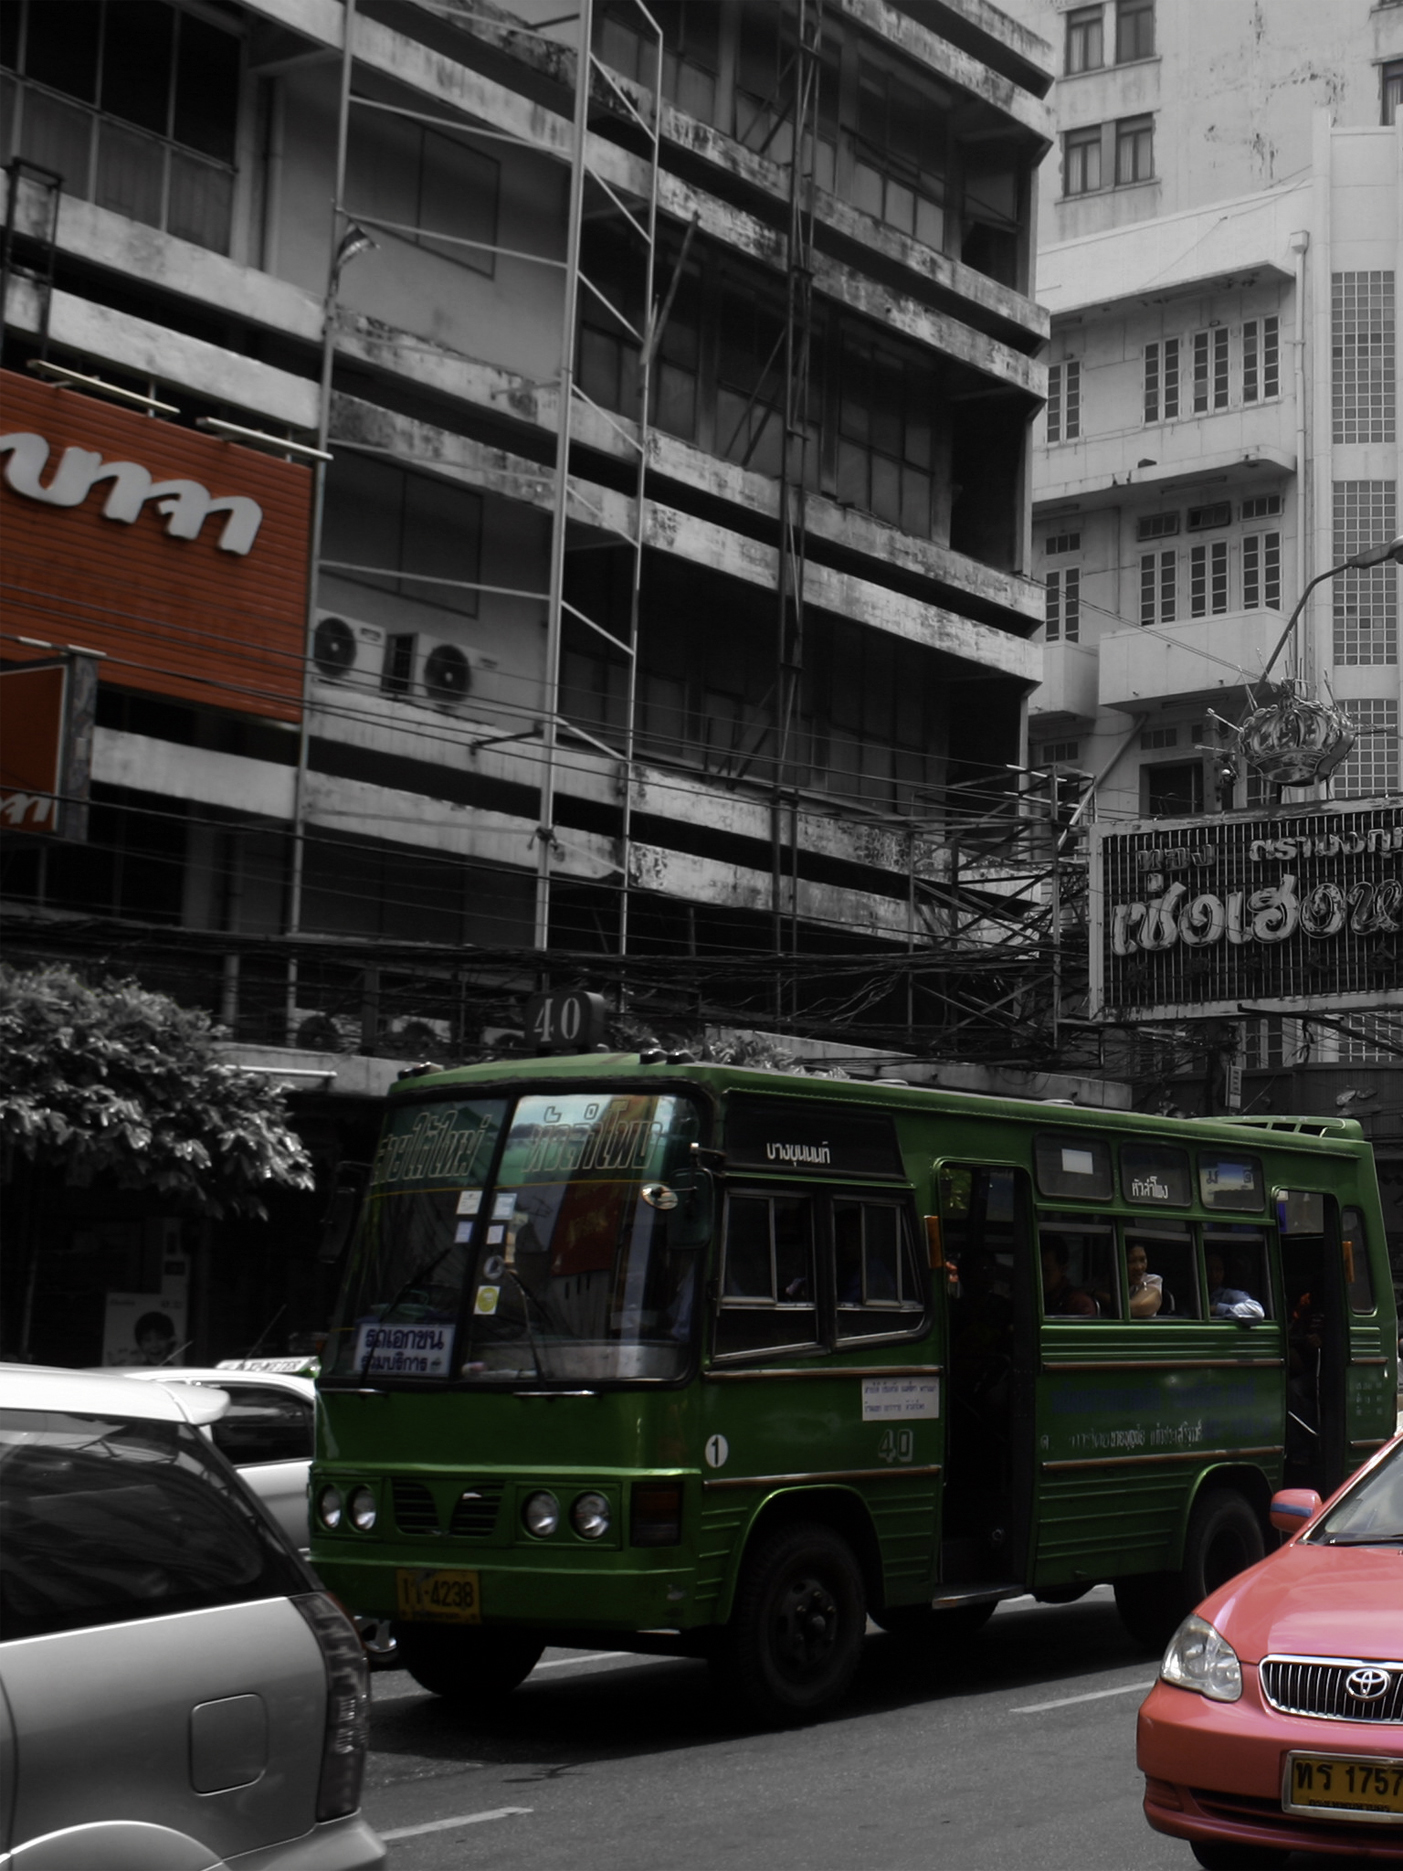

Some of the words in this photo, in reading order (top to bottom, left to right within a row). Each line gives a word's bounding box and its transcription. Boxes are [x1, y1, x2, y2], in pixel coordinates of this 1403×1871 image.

[533, 997, 581, 1042] 40
[1131, 1175, 1169, 1200] หัวลำโง
[365, 1328, 445, 1350] รถเอกชน
[878, 1428, 914, 1464] 40
